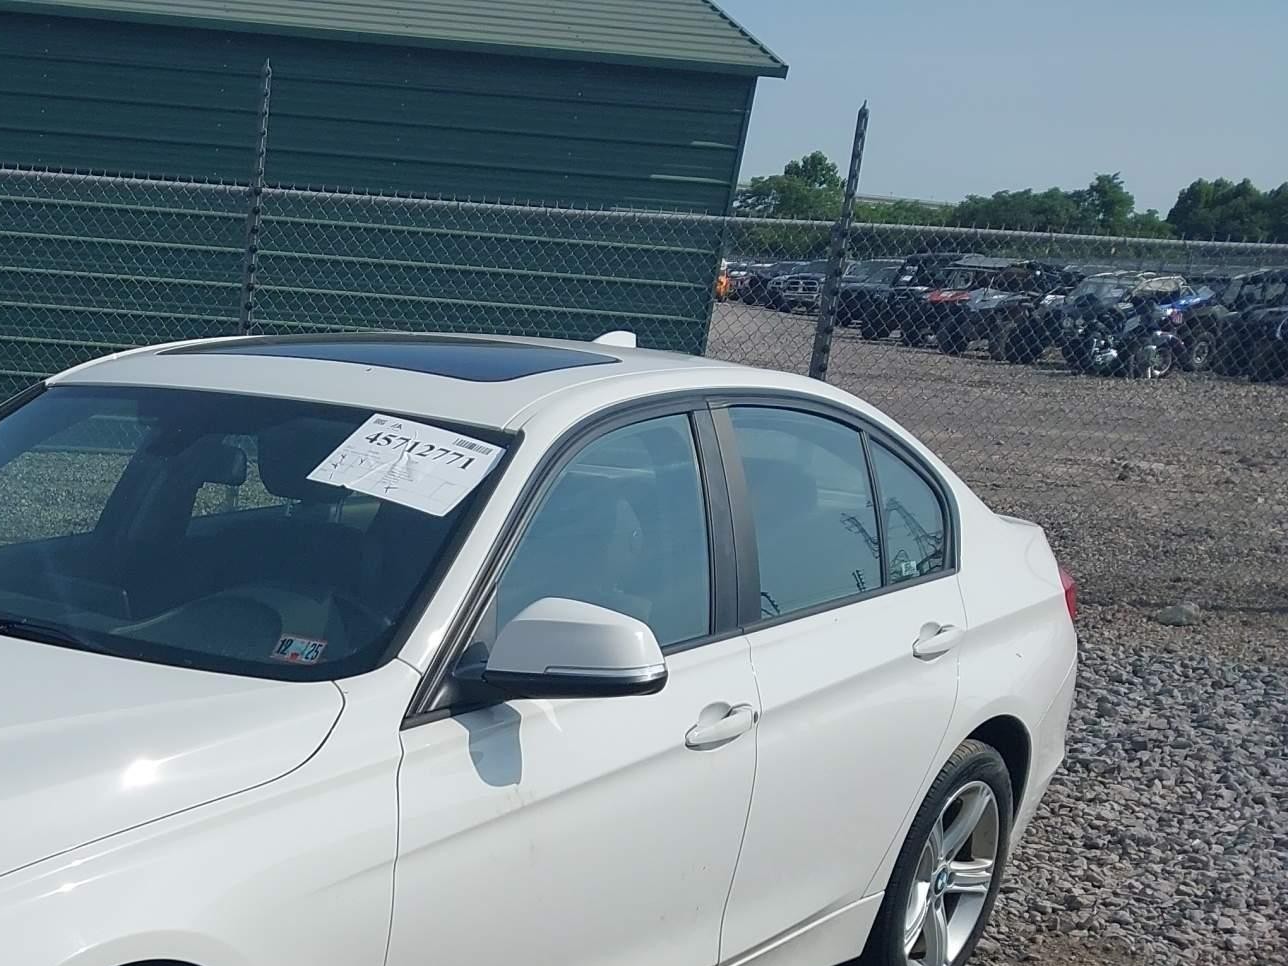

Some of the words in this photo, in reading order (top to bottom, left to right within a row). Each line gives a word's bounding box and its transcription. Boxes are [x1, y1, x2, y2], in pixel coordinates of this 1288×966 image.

[364, 431, 475, 471] 45712771
[276, 638, 294, 656] 12
[304, 642, 324, 661] 25
